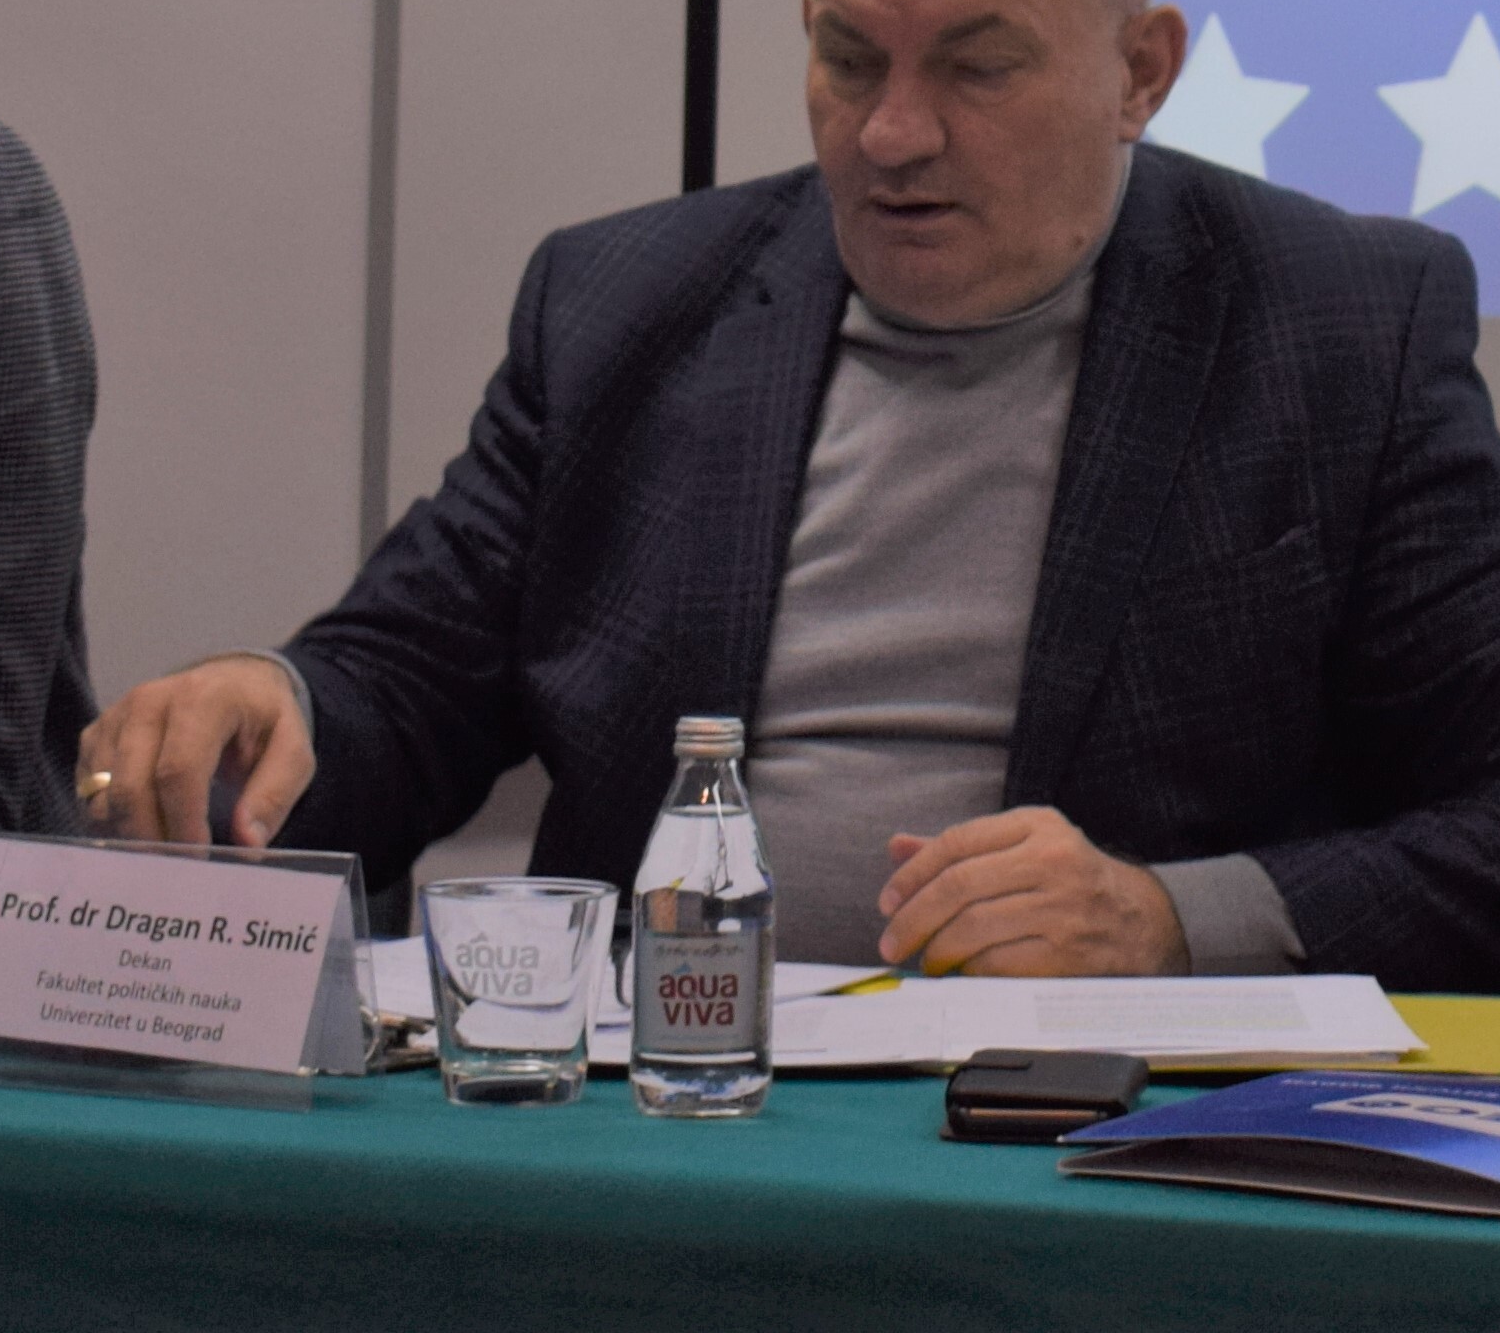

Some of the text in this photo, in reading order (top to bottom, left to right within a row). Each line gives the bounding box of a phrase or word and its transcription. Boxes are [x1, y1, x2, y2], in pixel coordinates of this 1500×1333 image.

[0, 892, 320, 954] Prof. dr Dragan R. Simić
[118, 948, 173, 973] Dekan
[455, 940, 540, 971] aqua
[35, 970, 242, 1013] Fakultet političkih nauka
[460, 970, 534, 998] viva
[658, 973, 739, 1000] aqua
[39, 1002, 226, 1044] Univerzitet u Beograd
[663, 1001, 735, 1027] viva
